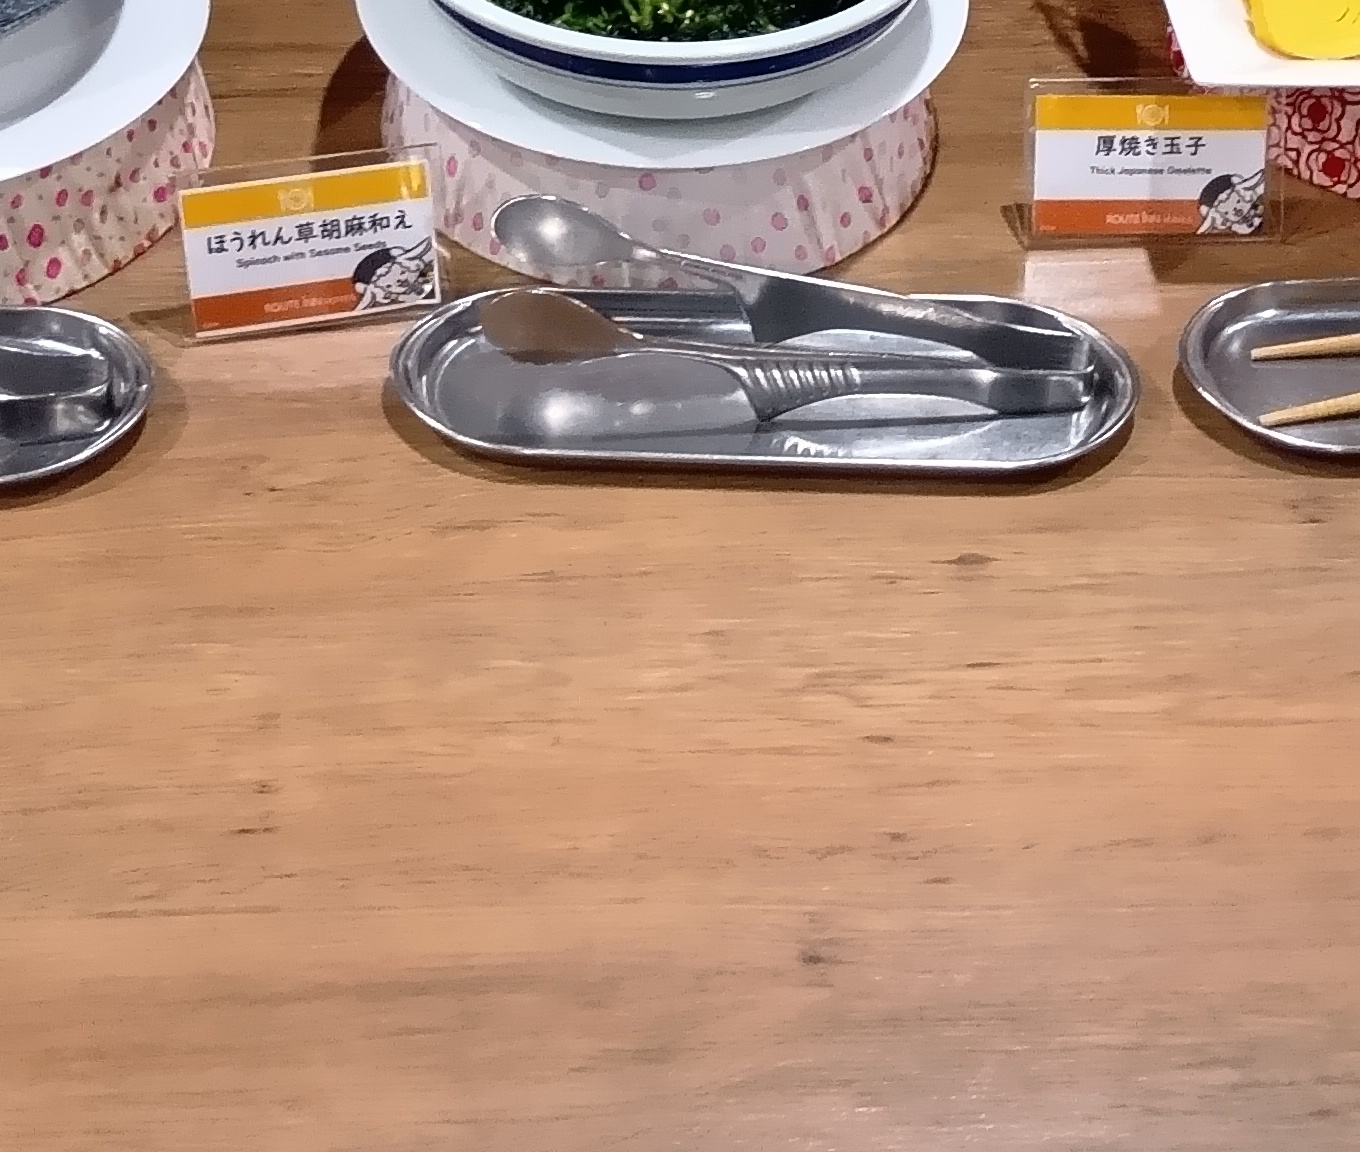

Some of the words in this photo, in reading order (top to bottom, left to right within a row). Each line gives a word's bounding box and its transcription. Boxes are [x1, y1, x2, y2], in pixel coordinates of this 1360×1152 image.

[1095, 135, 1208, 157] 厚焼き玉子
[206, 209, 413, 254] ほうれん草胡麻和え
[236, 255, 281, 269] Spinach
[283, 250, 306, 261] with
